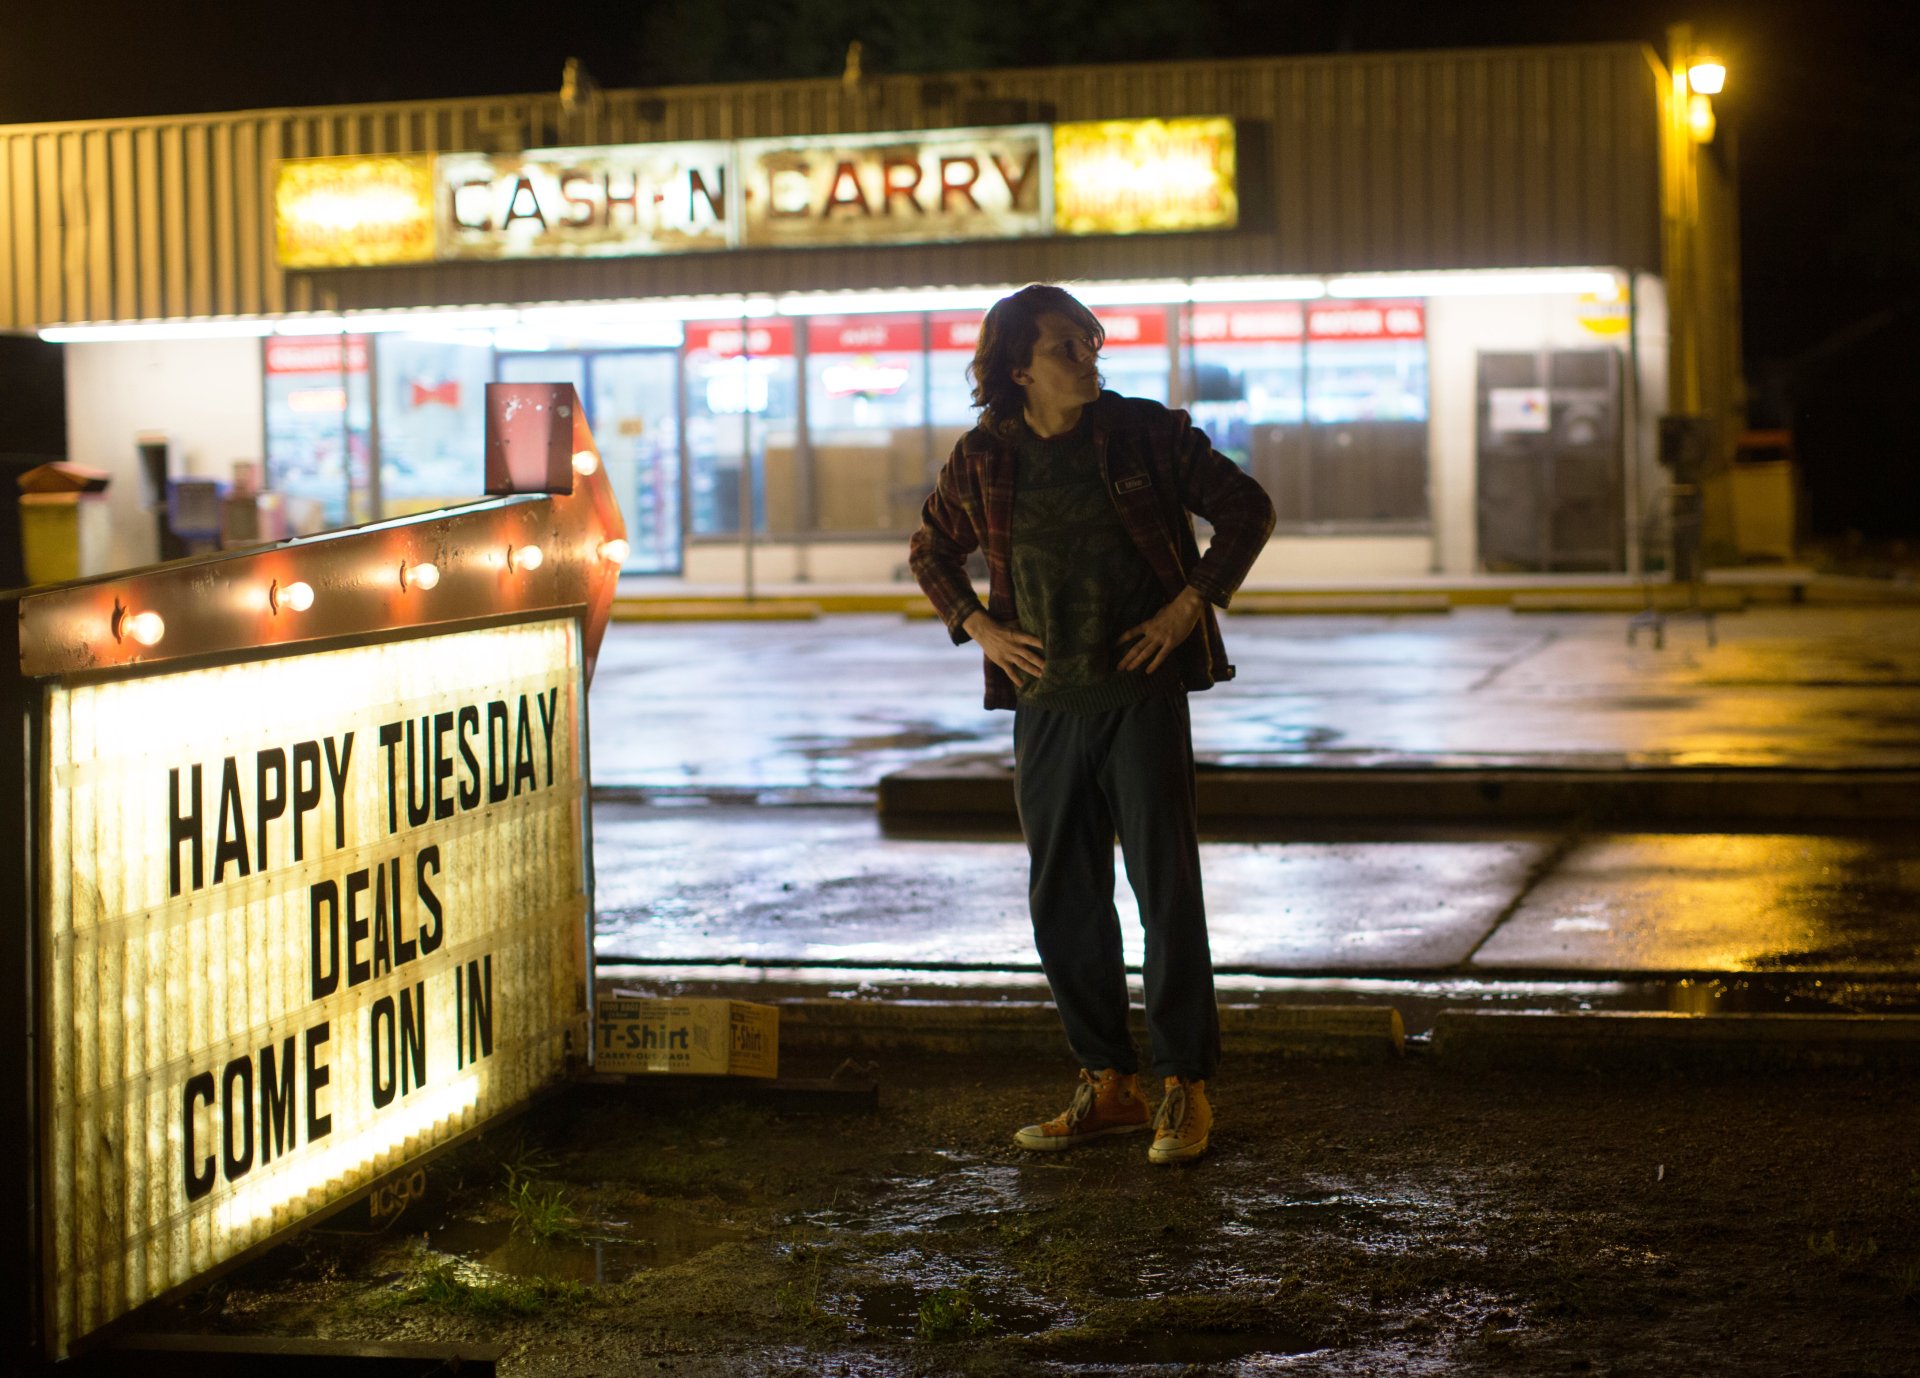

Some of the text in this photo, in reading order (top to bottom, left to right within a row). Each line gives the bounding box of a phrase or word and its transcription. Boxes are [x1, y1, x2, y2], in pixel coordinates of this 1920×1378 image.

[451, 167, 638, 232] CASH
[769, 151, 1039, 219] CARRY
[168, 687, 557, 897] HAPPY TUESDAY
[310, 846, 442, 1000] DEALS
[182, 955, 493, 1202] COME ON IN
[600, 1024, 689, 1049] T-Shirt
